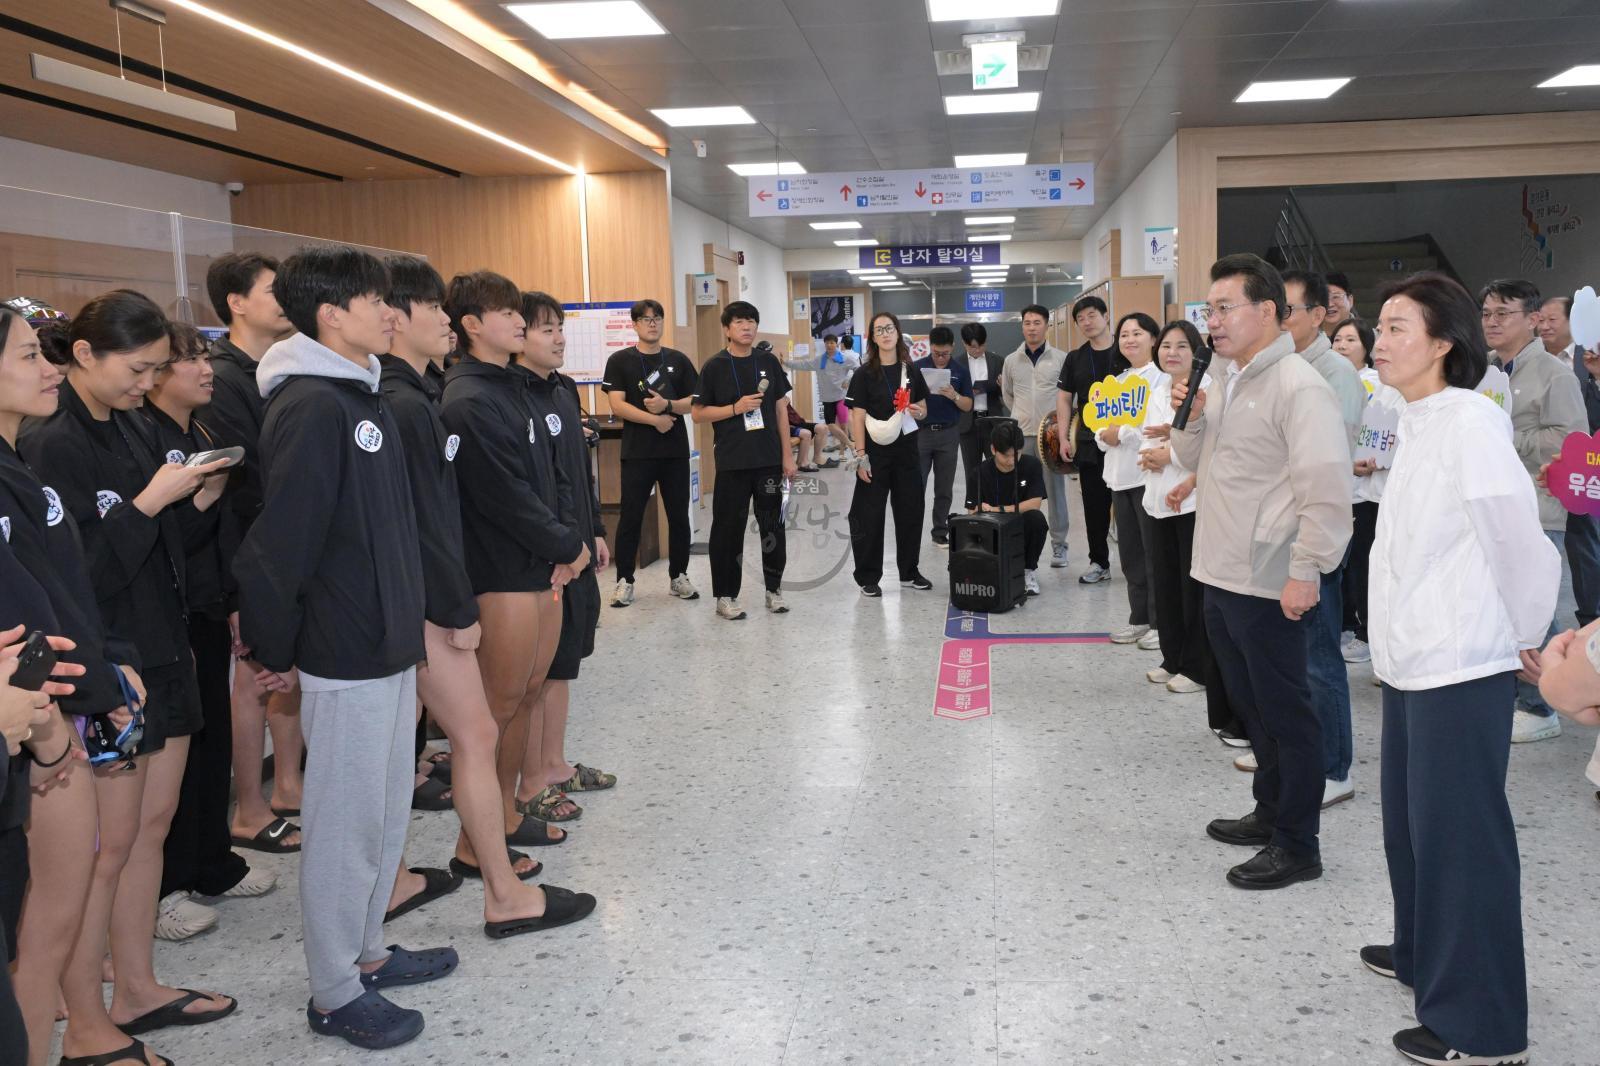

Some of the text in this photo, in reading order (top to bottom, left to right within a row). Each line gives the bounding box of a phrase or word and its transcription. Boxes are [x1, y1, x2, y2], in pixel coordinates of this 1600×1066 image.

[899, 246, 983, 264] 남자 탈의실
[972, 300, 997, 308] 보관장소
[1095, 385, 1146, 419] 파이팅!!
[1380, 429, 1396, 452] 남구
[955, 582, 996, 598] MIPRO
